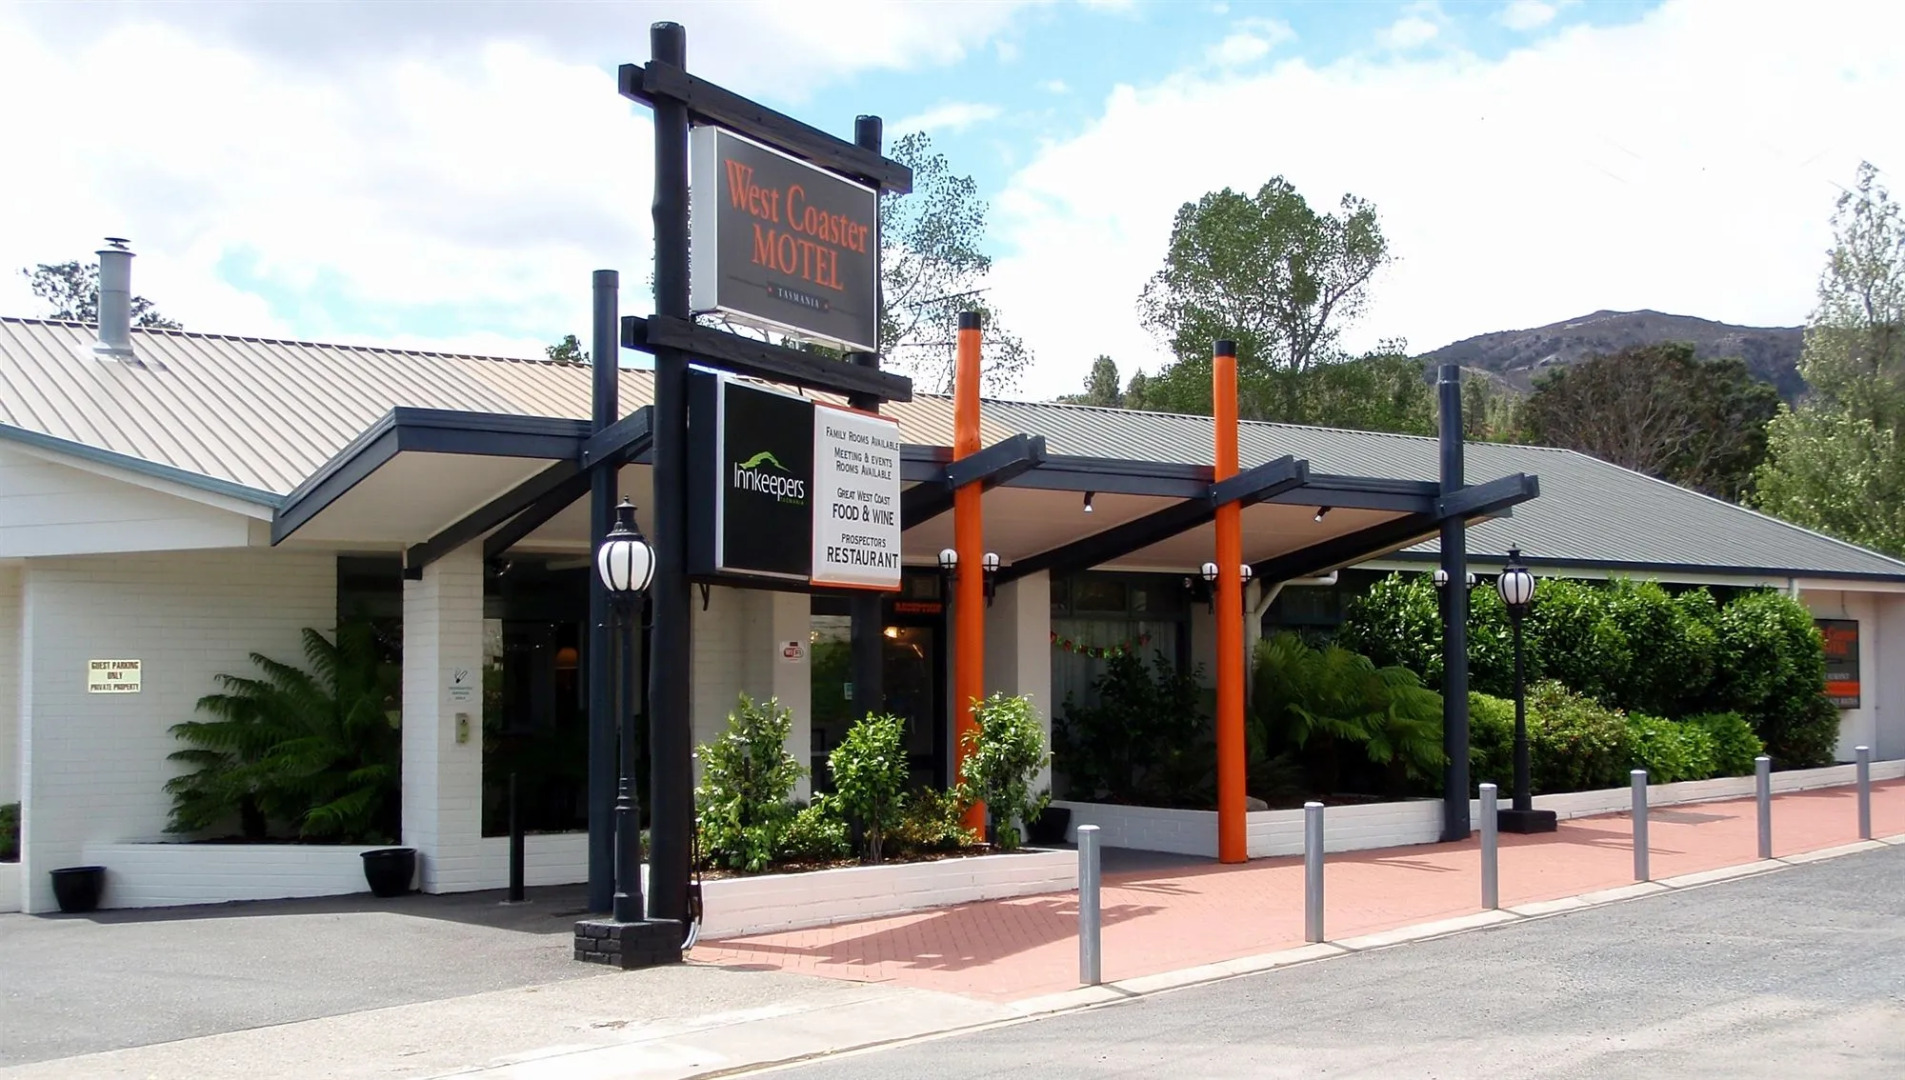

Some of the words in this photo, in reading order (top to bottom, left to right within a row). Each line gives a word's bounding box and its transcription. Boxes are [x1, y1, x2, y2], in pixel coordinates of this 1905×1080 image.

[724, 159, 779, 223] West
[786, 184, 868, 254] Coaster
[752, 224, 844, 291] MOTEL
[777, 287, 820, 309] TASMANIA
[826, 426, 846, 440] FAMILY
[848, 431, 869, 445] ROOMS
[871, 436, 899, 451] AVAILABLE
[834, 446, 862, 462] MEETING
[864, 452, 871, 463] &
[871, 455, 893, 468] EVENTS
[836, 460, 859, 474] ROOMS
[861, 465, 892, 480] AVAILABLE
[733, 461, 805, 502] Innkeepers
[837, 487, 856, 500] GREAT
[856, 490, 873, 503] WEST
[874, 493, 891, 506] COAST
[832, 503, 859, 521] FOOD
[862, 505, 870, 522] &
[872, 509, 894, 526] WINE
[841, 533, 887, 548] PROSPECTORS
[827, 546, 899, 569] RESTAURANT
[91, 661, 111, 670] GUEST
[112, 661, 139, 670] PARKING
[107, 671, 123, 680] ONLY
